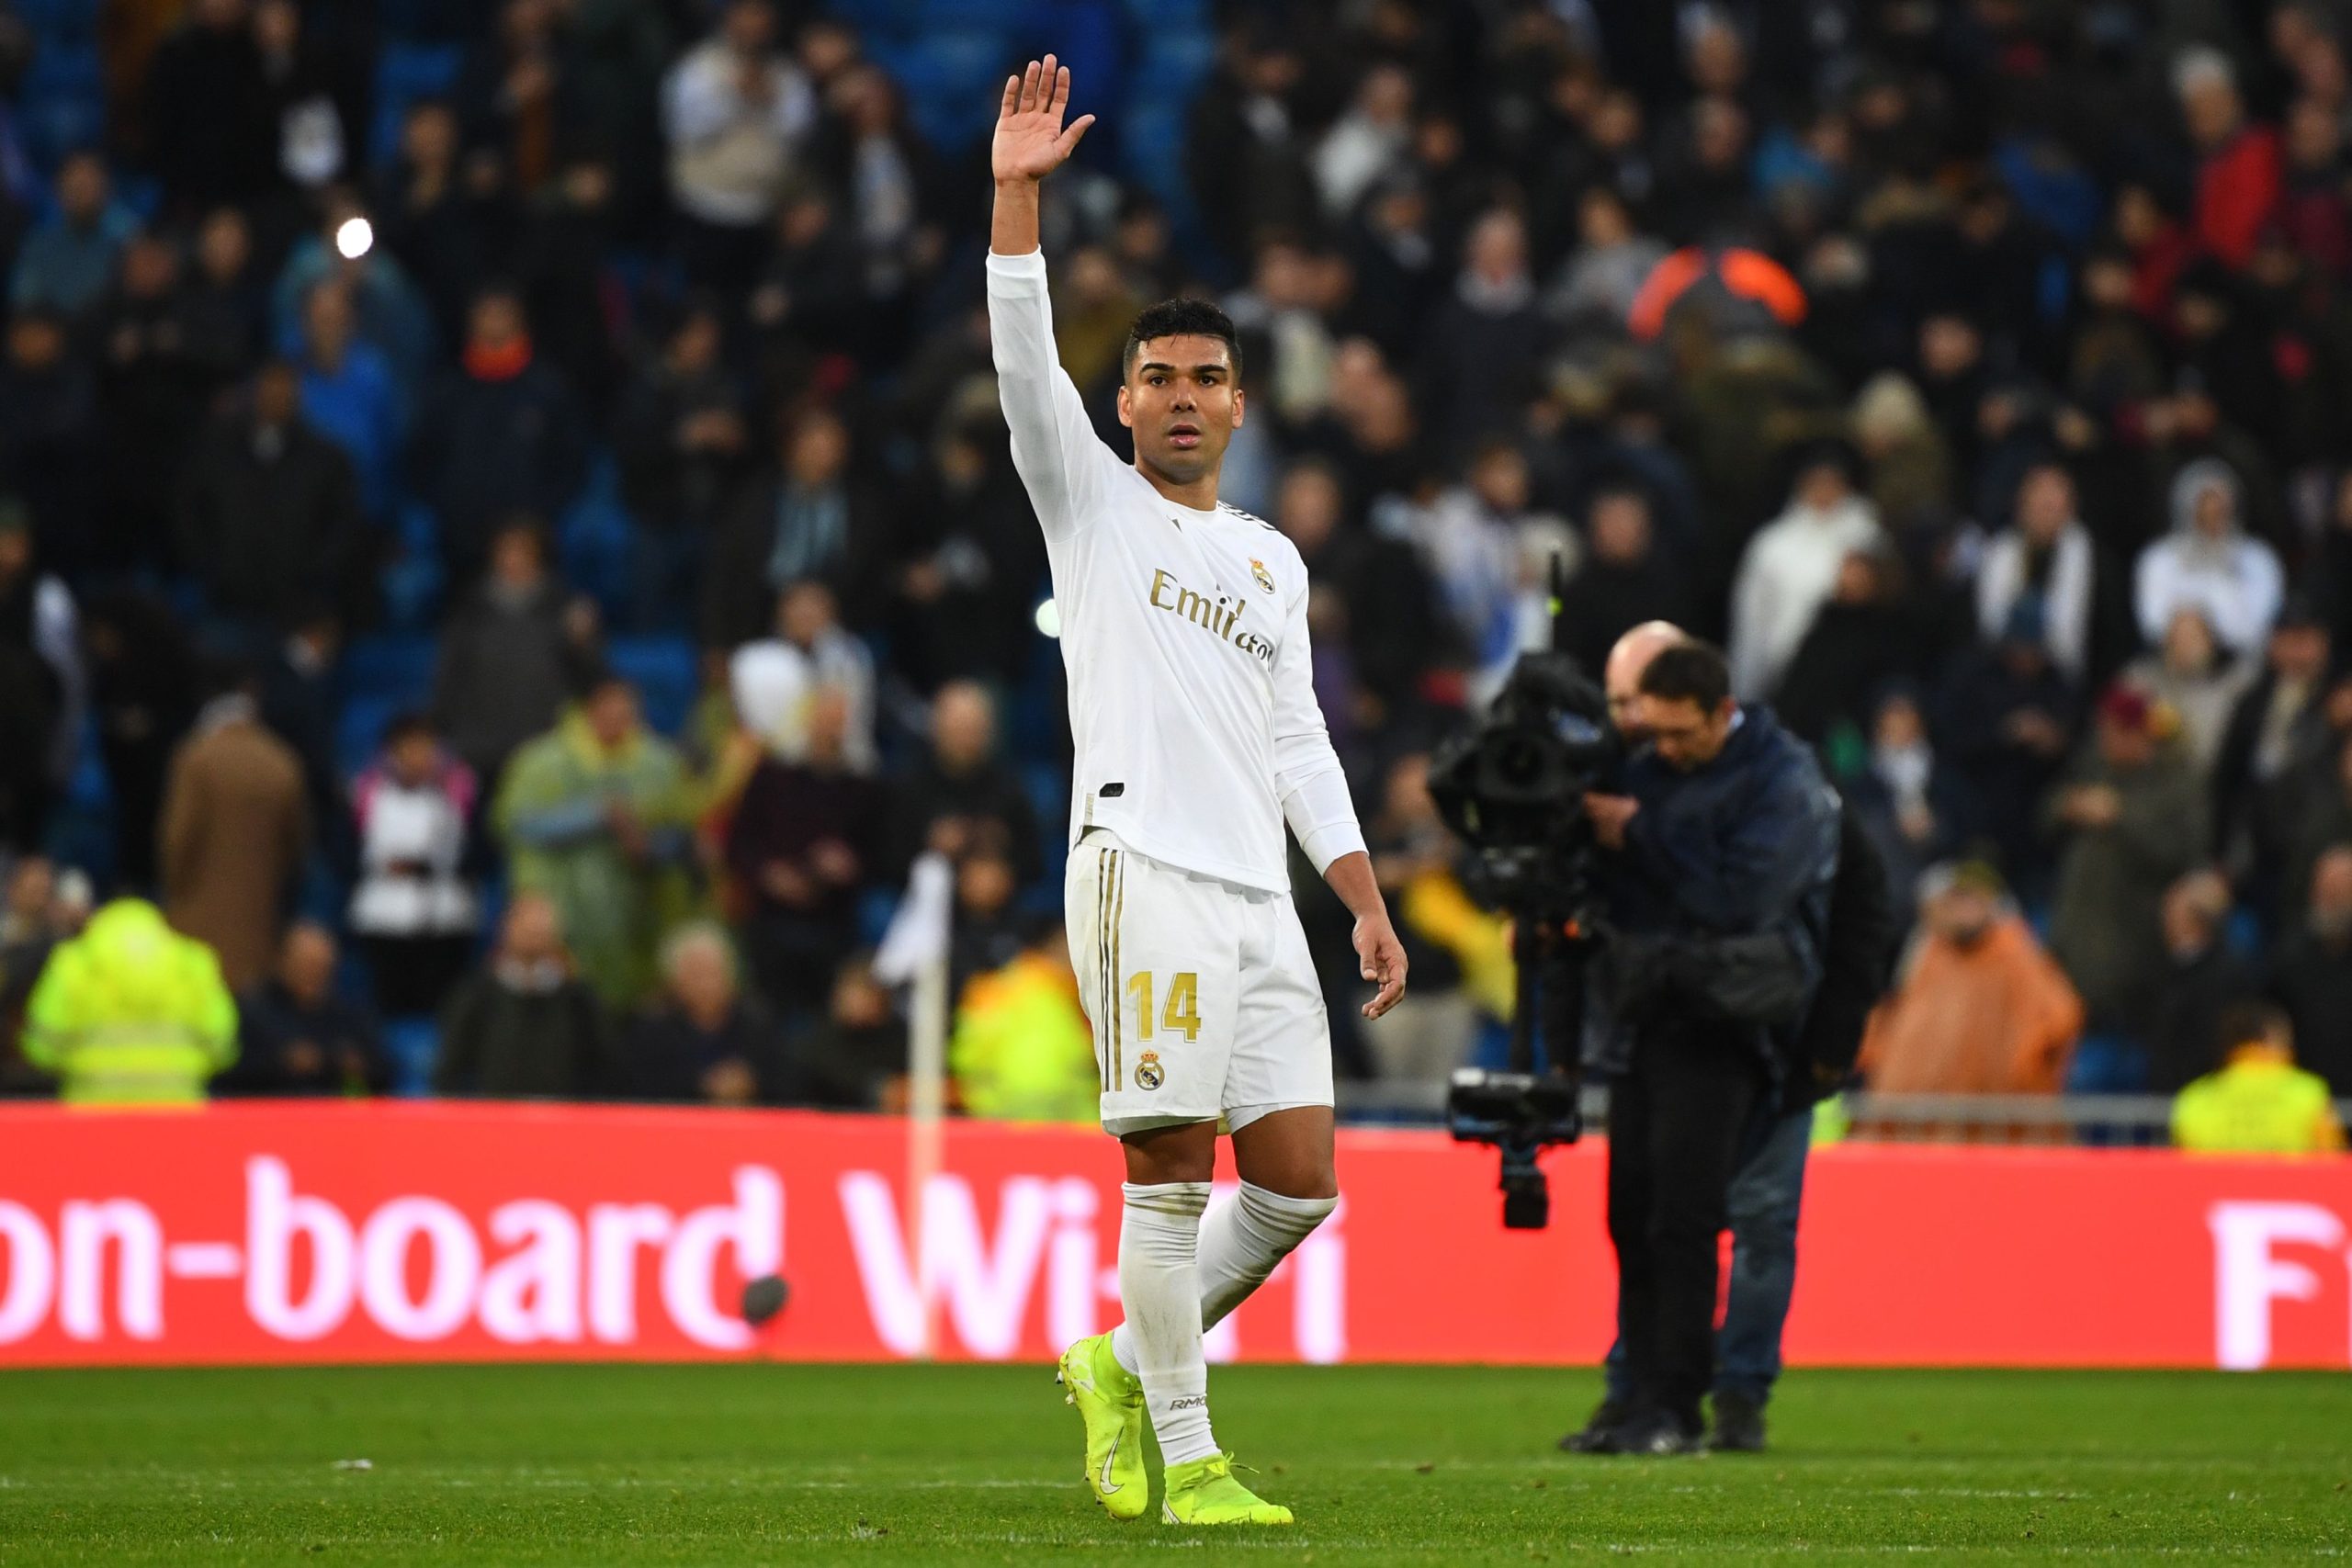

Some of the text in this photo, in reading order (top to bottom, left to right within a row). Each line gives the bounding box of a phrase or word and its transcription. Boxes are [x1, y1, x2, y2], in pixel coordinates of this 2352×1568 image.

[1149, 568, 1272, 672] Emira
[1126, 970, 1202, 1043] 14
[2207, 1200, 2352, 1367] F
